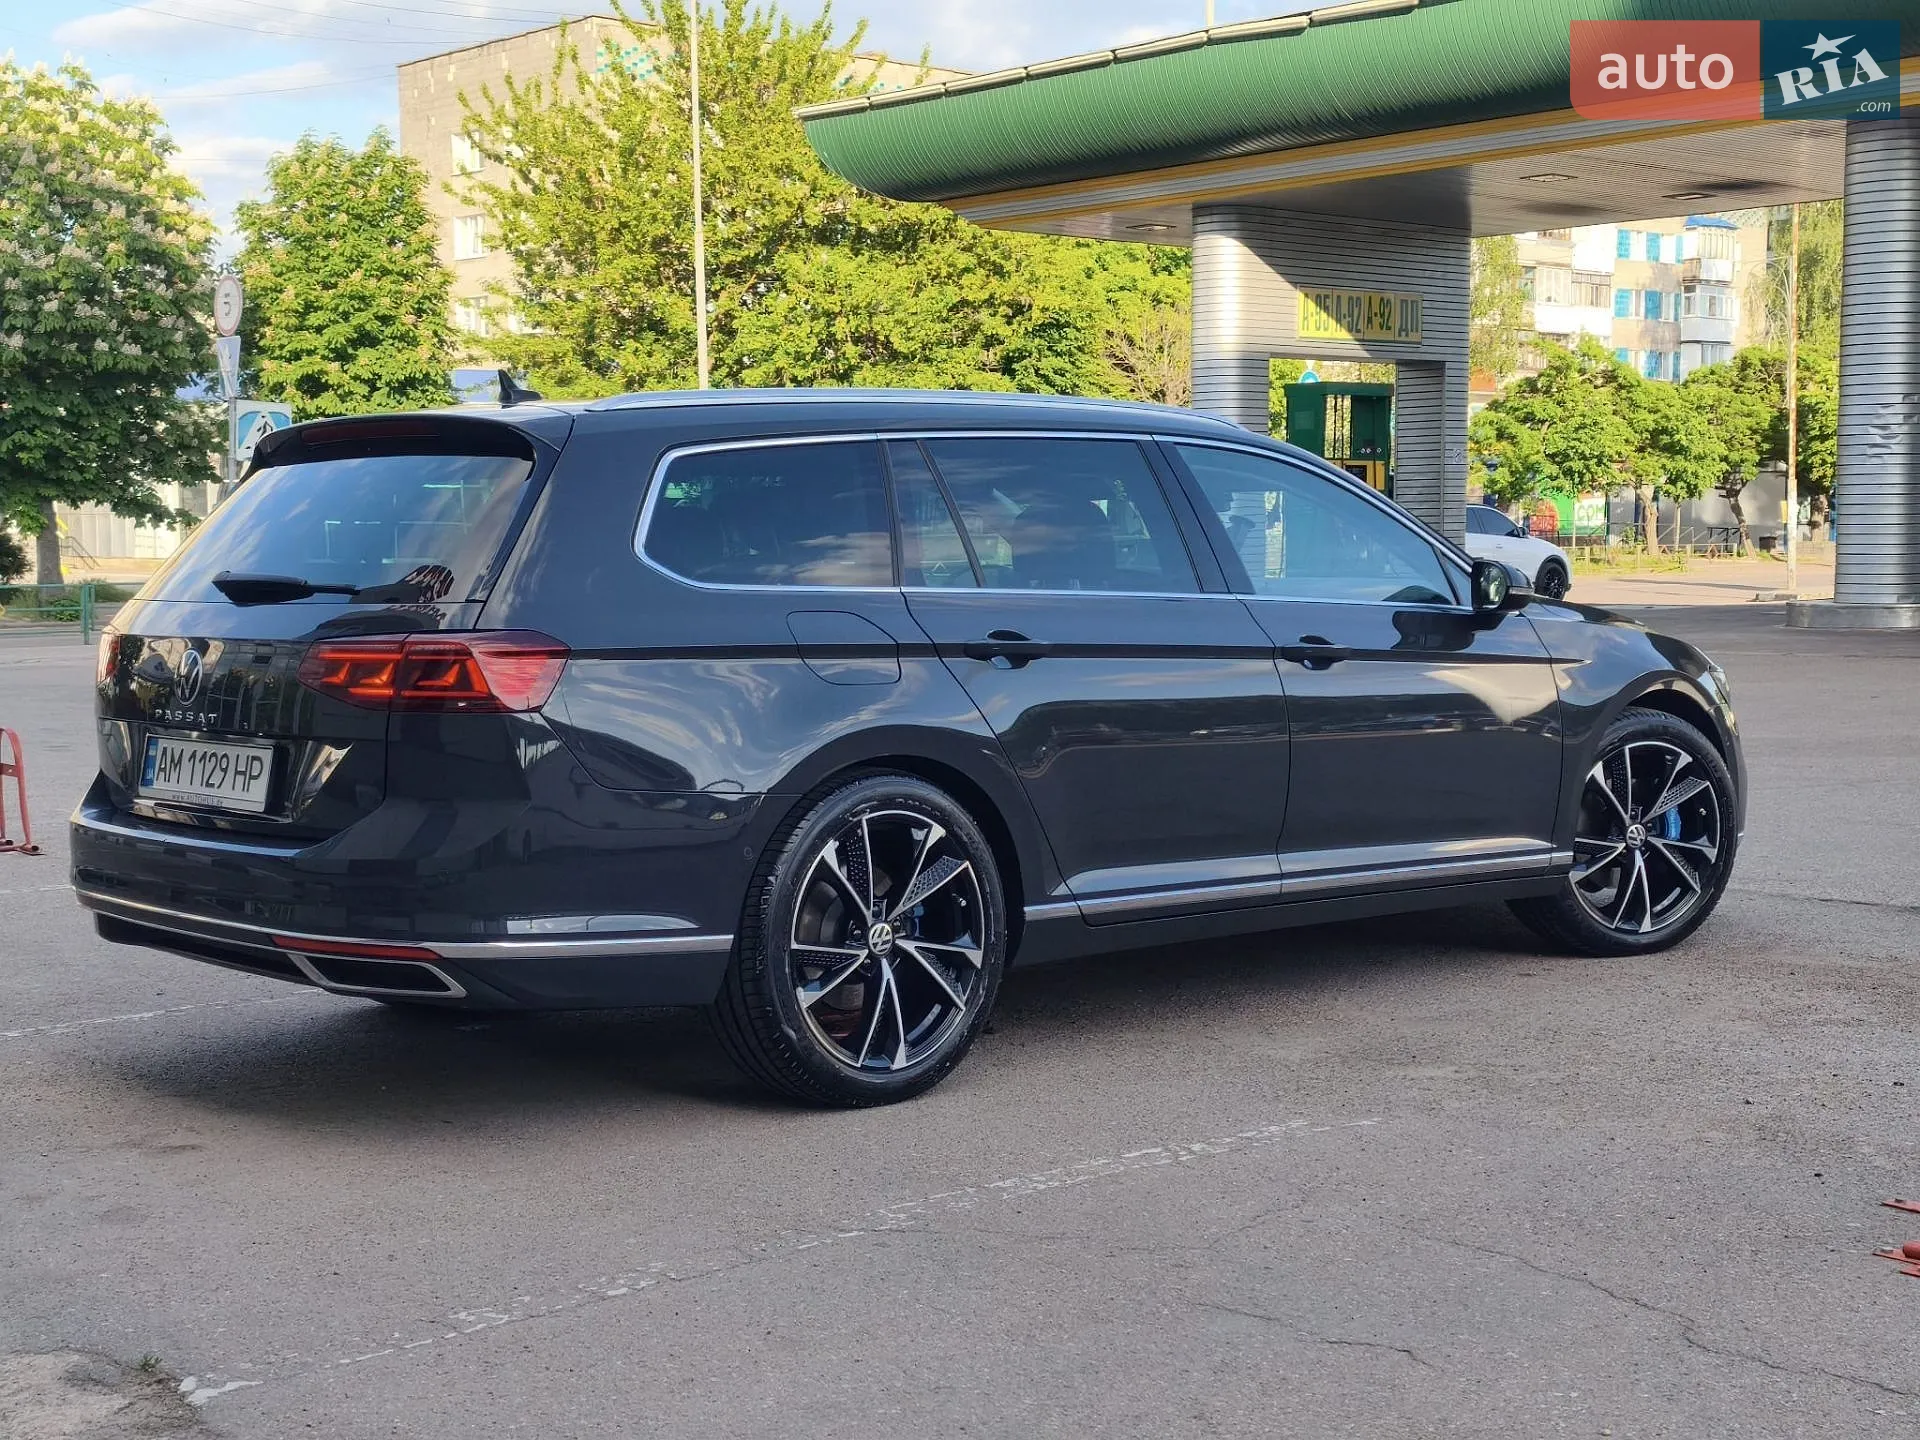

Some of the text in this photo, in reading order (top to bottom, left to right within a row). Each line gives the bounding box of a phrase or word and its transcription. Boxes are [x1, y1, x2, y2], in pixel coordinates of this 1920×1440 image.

[155, 708, 218, 724] PASSAT
[156, 745, 263, 793] AM 1129 HP
